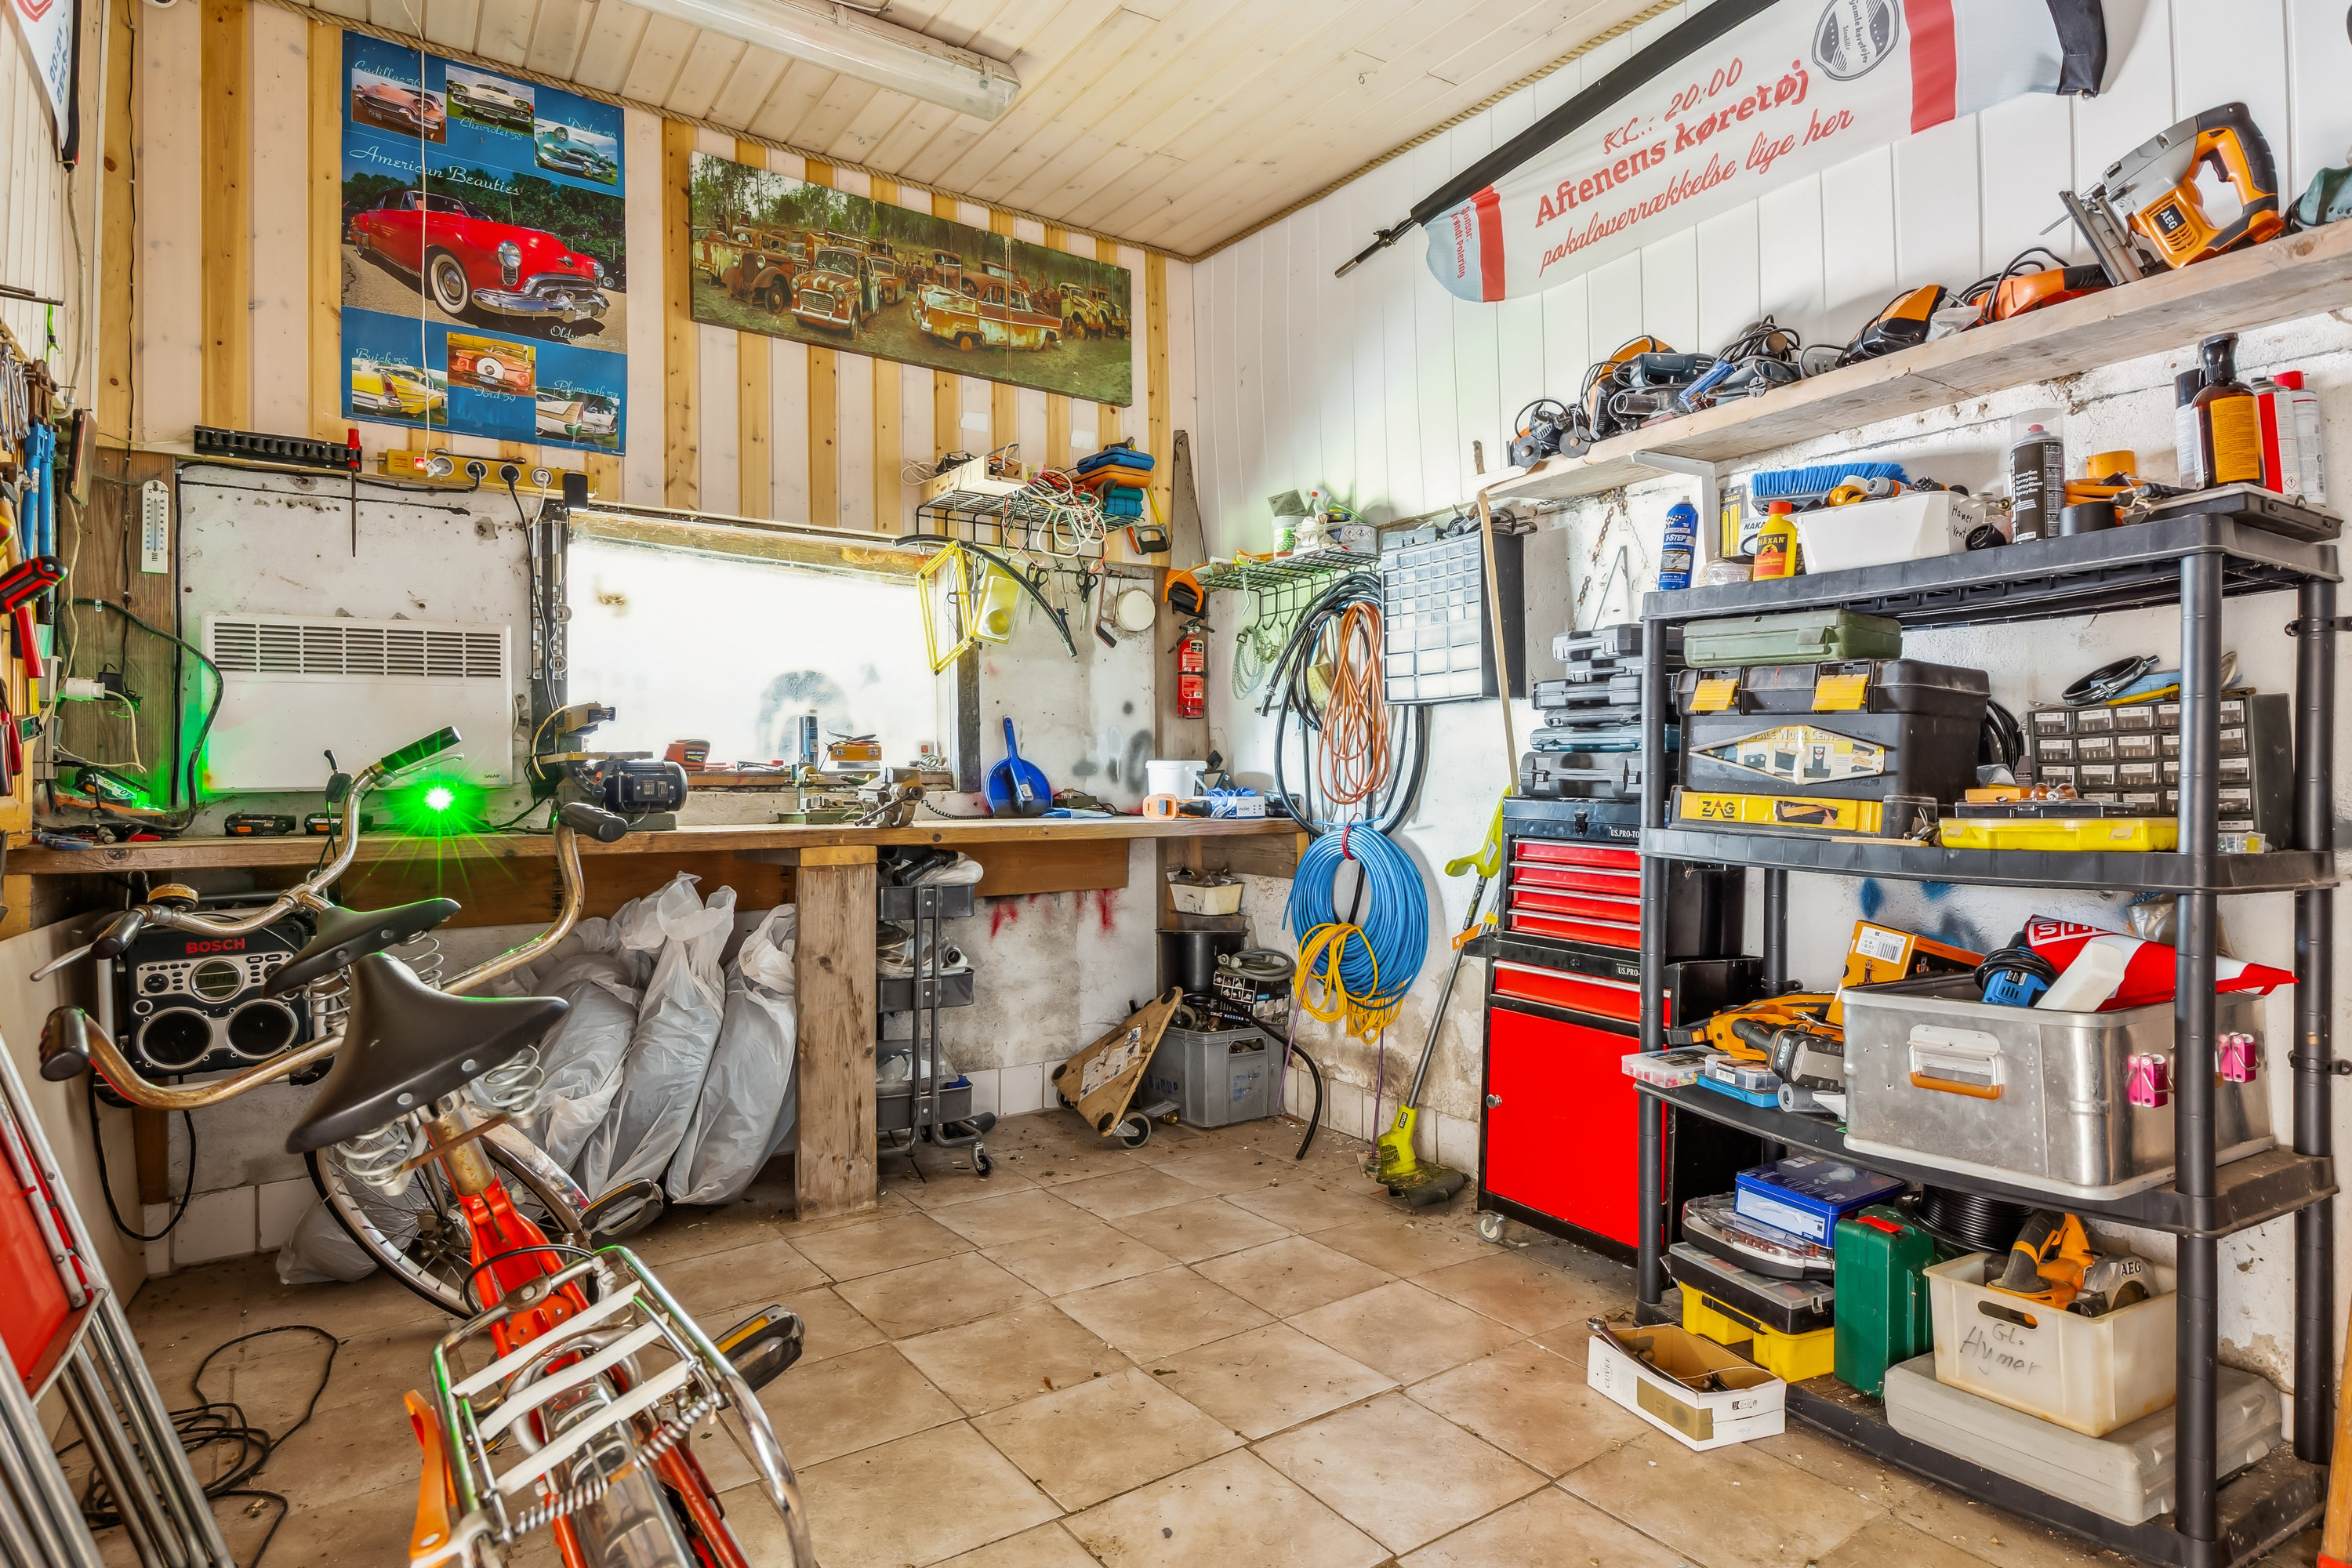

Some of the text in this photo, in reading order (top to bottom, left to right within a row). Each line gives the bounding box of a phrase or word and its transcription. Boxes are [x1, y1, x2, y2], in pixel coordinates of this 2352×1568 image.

[354, 60, 405, 84] Cadillac
[1664, 57, 1743, 122] 20:00
[459, 117, 510, 137] Chevrolet
[568, 117, 603, 137] Dodge
[1535, 59, 1809, 228] Aftenens køretøj
[349, 146, 521, 196] American Beauties
[1538, 107, 1855, 278] pokaloverrækkelse lige her
[2160, 210, 2178, 230] AEG
[1456, 240, 1467, 279] Polering
[355, 347, 390, 365] Buick
[473, 385, 502, 400] Ford
[554, 379, 605, 398] Plymouth
[1701, 799, 1736, 818] ZAG
[186, 938, 245, 954] BOSCH
[1779, 1047, 1788, 1066] AEG
[1399, 1112, 1408, 1128] RYOBI
[2121, 1261, 2141, 1276] AEG
